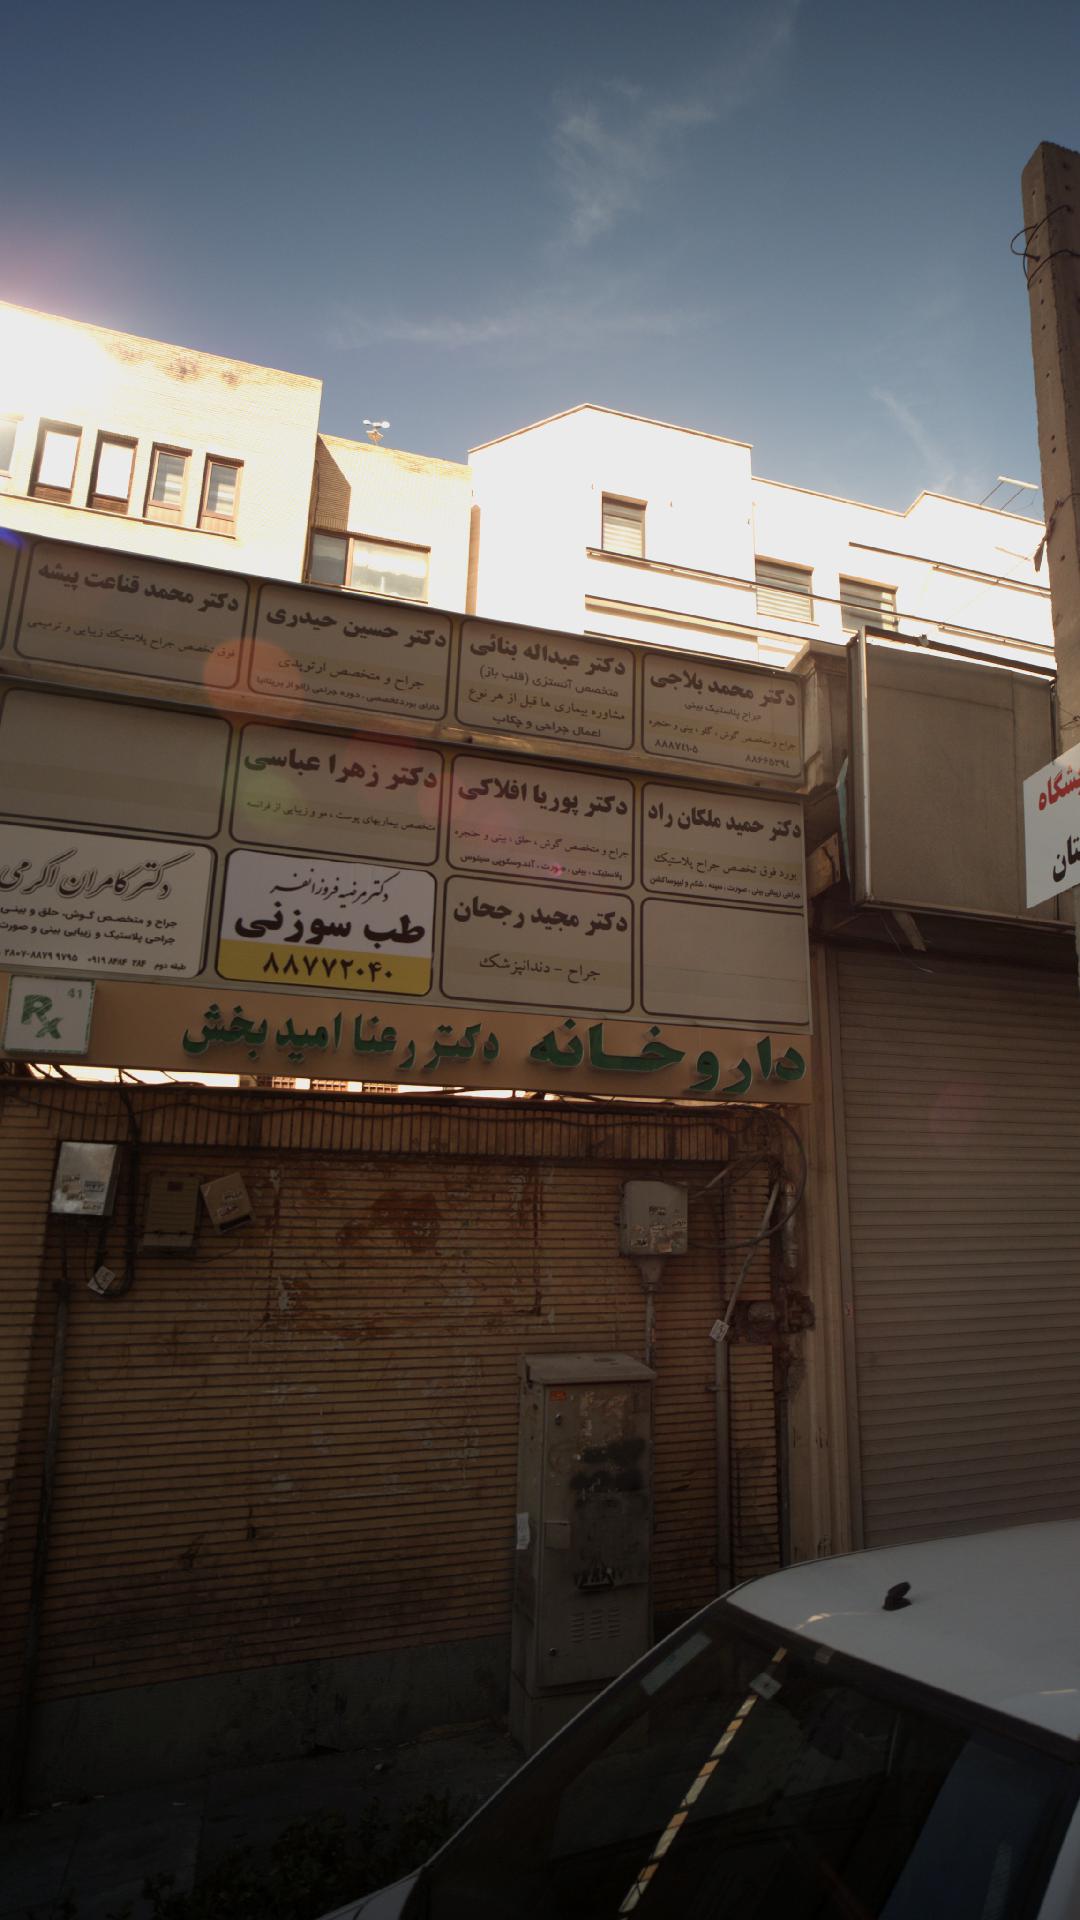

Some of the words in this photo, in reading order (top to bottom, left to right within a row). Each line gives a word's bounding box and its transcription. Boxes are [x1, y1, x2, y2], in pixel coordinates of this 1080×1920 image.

[37, 562, 80, 592] پیشه
[84, 573, 140, 594] قناعت
[144, 584, 194, 604] محمد
[197, 591, 239, 612] دکتر
[266, 608, 337, 631] حیدری
[65, 624, 71, 633] و
[342, 620, 399, 639] حسین
[106, 628, 147, 646] پلاستیک
[150, 637, 175, 650] جراح
[403, 629, 447, 648] دکتر
[178, 642, 215, 654] تخصص
[470, 633, 518, 658] بنائی
[523, 643, 580, 669] عبداله
[278, 658, 327, 676] ارتوپدی
[329, 668, 380, 681] متخصص
[480, 664, 499, 680] باز)
[584, 657, 626, 676] دکتر
[383, 675, 392, 686] و
[394, 673, 424, 691] جراح
[501, 671, 529, 686] (قلب
[468, 687, 488, 703] نوع
[490, 692, 504, 703] هر
[507, 692, 517, 704] از
[575, 685, 619, 698] متخصص
[708, 680, 754, 700] محمد
[759, 689, 796, 707] دکتر
[520, 693, 537, 709] قبل
[540, 696, 551, 708] ها
[554, 701, 588, 717] بیماری
[684, 701, 703, 711] بینی
[591, 707, 625, 721] مشاوره
[704, 704, 740, 720] پلاستیک
[742, 710, 762, 722] جراح
[526, 719, 533, 730] و
[535, 721, 569, 734] جراحی
[572, 726, 601, 738] اعمال
[673, 723, 679, 731] و
[771, 739, 778, 748] و
[778, 739, 796, 752] جراح
[244, 748, 321, 776] عباسی
[328, 753, 380, 788] زهرا
[385, 766, 437, 790] دکتر
[458, 776, 528, 802] افلاکی
[246, 800, 270, 812] فرانسه
[272, 802, 281, 812] از
[532, 783, 578, 816] پوریا
[584, 795, 628, 817] دکتر
[316, 810, 328, 820] مو
[648, 801, 674, 829] راد
[677, 807, 721, 830] ملکان
[400, 821, 436, 831] متخصص
[725, 815, 765, 836] حمید
[769, 819, 801, 842] دکتر
[608, 847, 630, 860] جراح
[653, 850, 694, 870] پلاستیک
[0, 847, 79, 894] اکرمی
[696, 858, 721, 874] جراح
[722, 864, 757, 875] تخصص
[760, 865, 777, 879] فوق
[57, 862, 140, 899] کامران
[122, 850, 195, 901] دکتر
[338, 881, 367, 908] مرضیه
[361, 871, 400, 905] دکتر
[0, 904, 27, 915] بینی
[29, 906, 36, 917] و
[38, 906, 60, 918] حلق
[454, 896, 525, 928] رجحان
[0, 922, 29, 933] صورت
[97, 914, 144, 925] متخصص
[146, 918, 153, 928] و
[155, 917, 178, 929] جراح
[235, 900, 352, 945] سوزنی
[530, 907, 580, 932] مجید
[584, 912, 628, 936] دکتر
[30, 925, 37, 935] و
[40, 925, 61, 936] بینی
[63, 926, 92, 939] زیبایی
[95, 931, 101, 940] و
[104, 929, 144, 944] پلاستیک
[364, 914, 425, 949] طب
[145, 934, 176, 946] جراحی
[263, 952, 392, 983] ۸۸۷۷۲۰۴۰
[480, 952, 550, 976] دندانپزشک
[567, 963, 600, 984] جراح
[422, 1022, 500, 1072] دکتر
